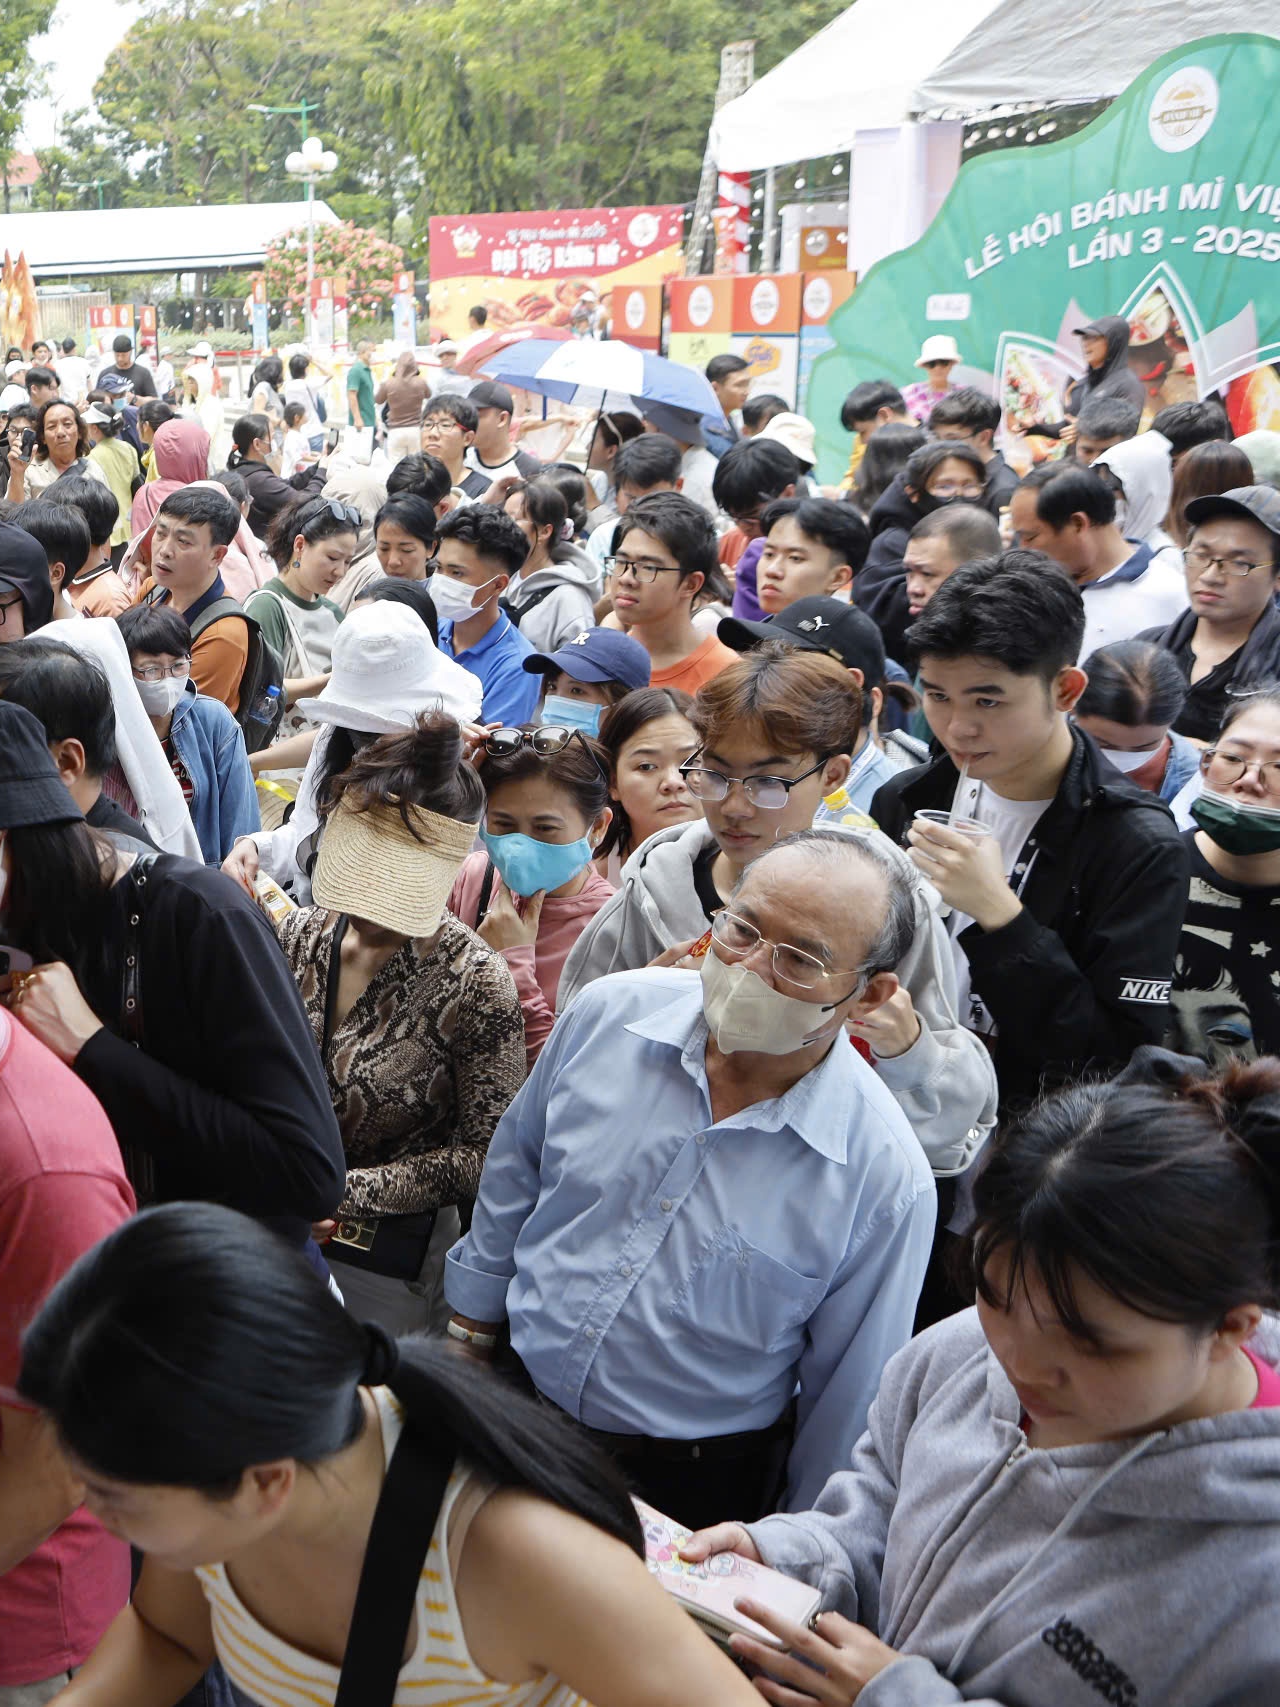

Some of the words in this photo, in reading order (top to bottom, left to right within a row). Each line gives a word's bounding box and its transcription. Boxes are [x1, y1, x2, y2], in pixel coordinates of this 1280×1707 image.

[964, 233, 1005, 280] LỄ
[1008, 212, 1062, 254] HỘI
[1070, 186, 1169, 230] BÁNH
[1140, 227, 1164, 254] 3
[1193, 225, 1280, 262] 2025
[570, 632, 590, 645] R
[1120, 981, 1172, 1000] NIKE
